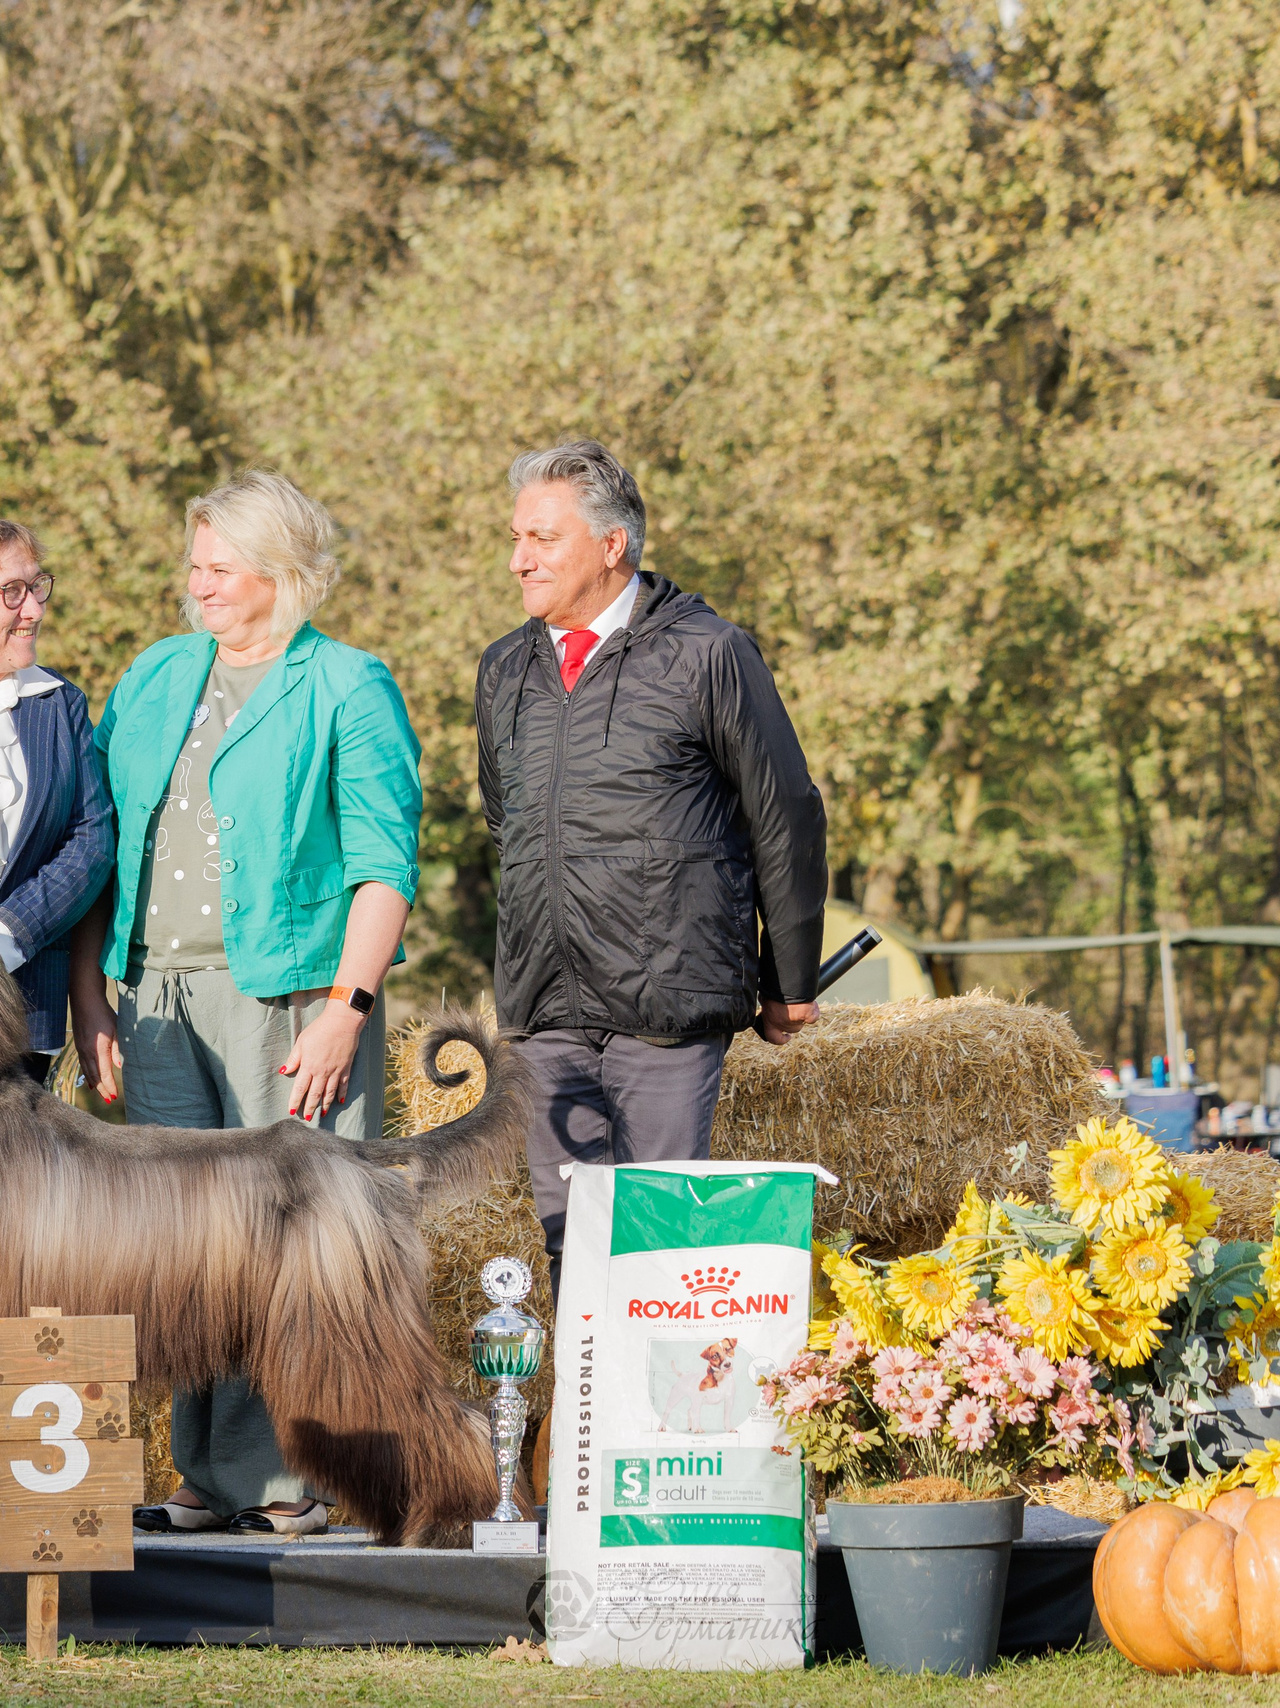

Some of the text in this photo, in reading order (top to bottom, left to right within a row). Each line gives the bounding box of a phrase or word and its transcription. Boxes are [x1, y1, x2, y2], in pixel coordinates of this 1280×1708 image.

[628, 1294, 789, 1320] ROYAL CANIN
[10, 1381, 90, 1493] 3
[577, 1336, 594, 1512] PROFESSIONAL
[656, 1451, 722, 1476] mini
[621, 1466, 642, 1500] S
[656, 1485, 707, 1501] adult
